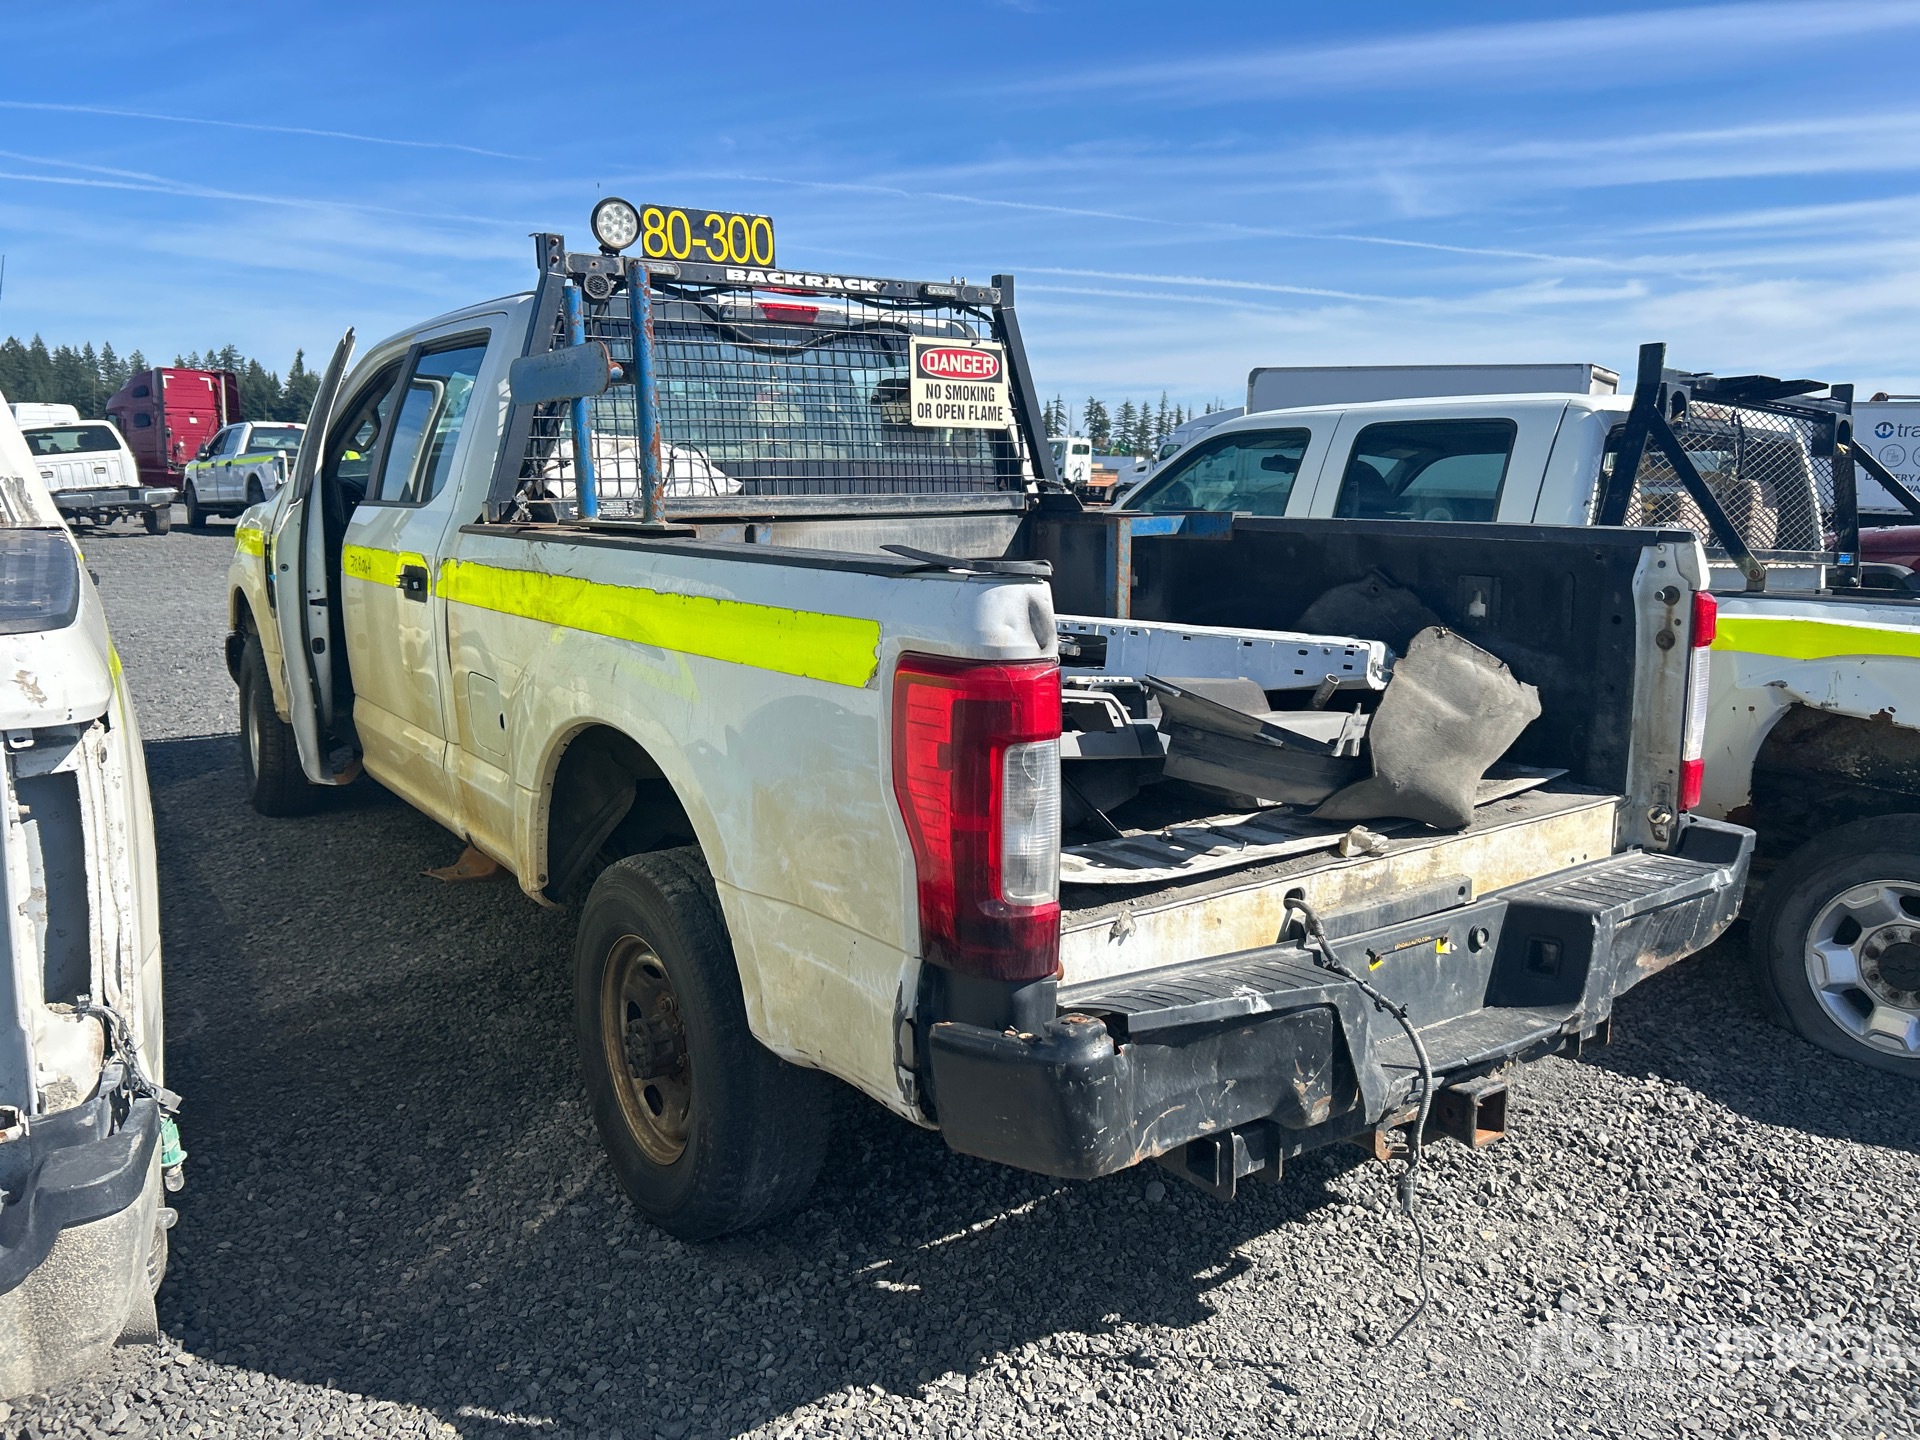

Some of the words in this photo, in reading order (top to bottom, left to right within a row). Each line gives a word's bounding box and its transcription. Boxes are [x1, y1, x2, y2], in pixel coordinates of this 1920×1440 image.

[643, 207, 774, 265] 80-300
[725, 268, 879, 293] BACKRACK
[926, 352, 995, 375] DANGER
[925, 383, 941, 400] NO
[945, 384, 995, 403] SMOKING
[917, 402, 932, 419] OR
[935, 403, 965, 420] OPEN
[968, 404, 1003, 422] FLAME
